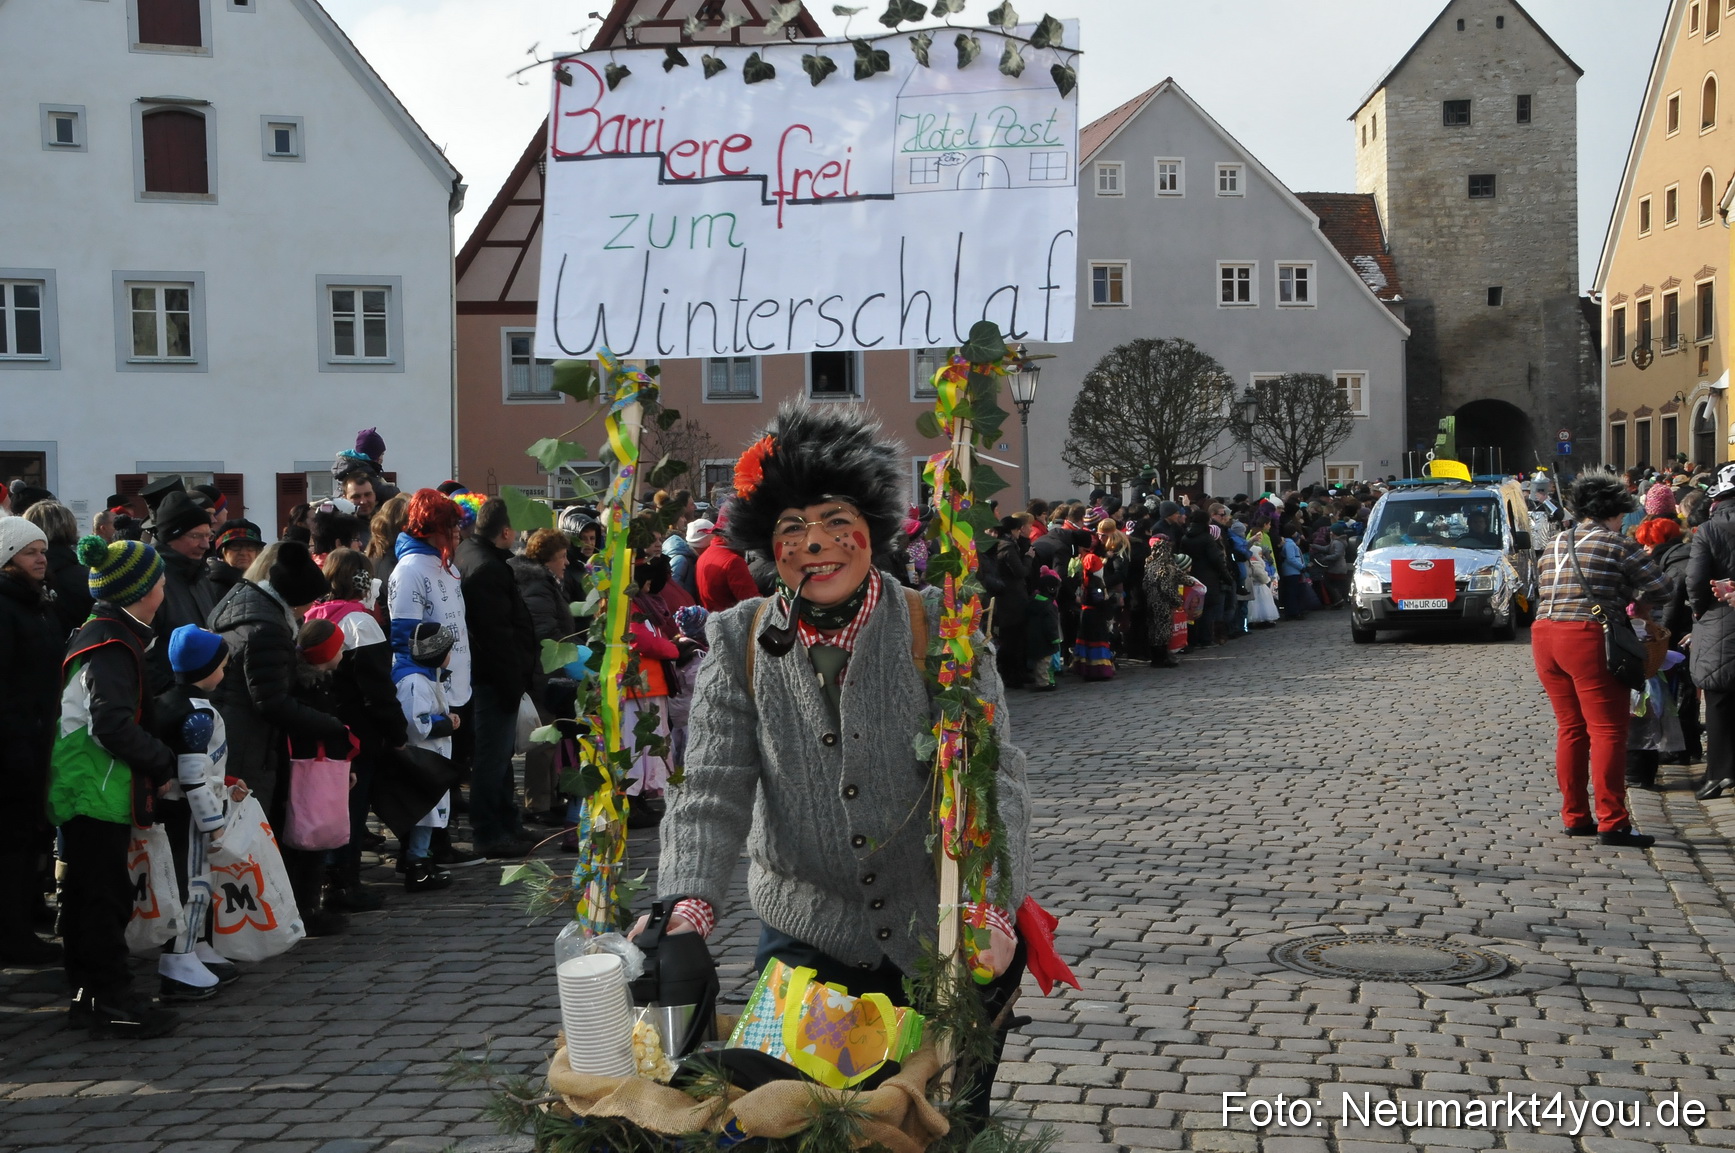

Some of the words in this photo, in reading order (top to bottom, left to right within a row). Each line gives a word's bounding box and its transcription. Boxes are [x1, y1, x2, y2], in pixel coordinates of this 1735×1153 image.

[898, 112, 979, 151] Hotel
[988, 105, 1060, 147] Post
[771, 123, 858, 229] frei
[603, 212, 744, 250] zum
[553, 229, 1074, 357] Winterschlaf
[1420, 600, 1430, 609] UR
[1431, 599, 1447, 608] 600
[220, 882, 258, 914] M
